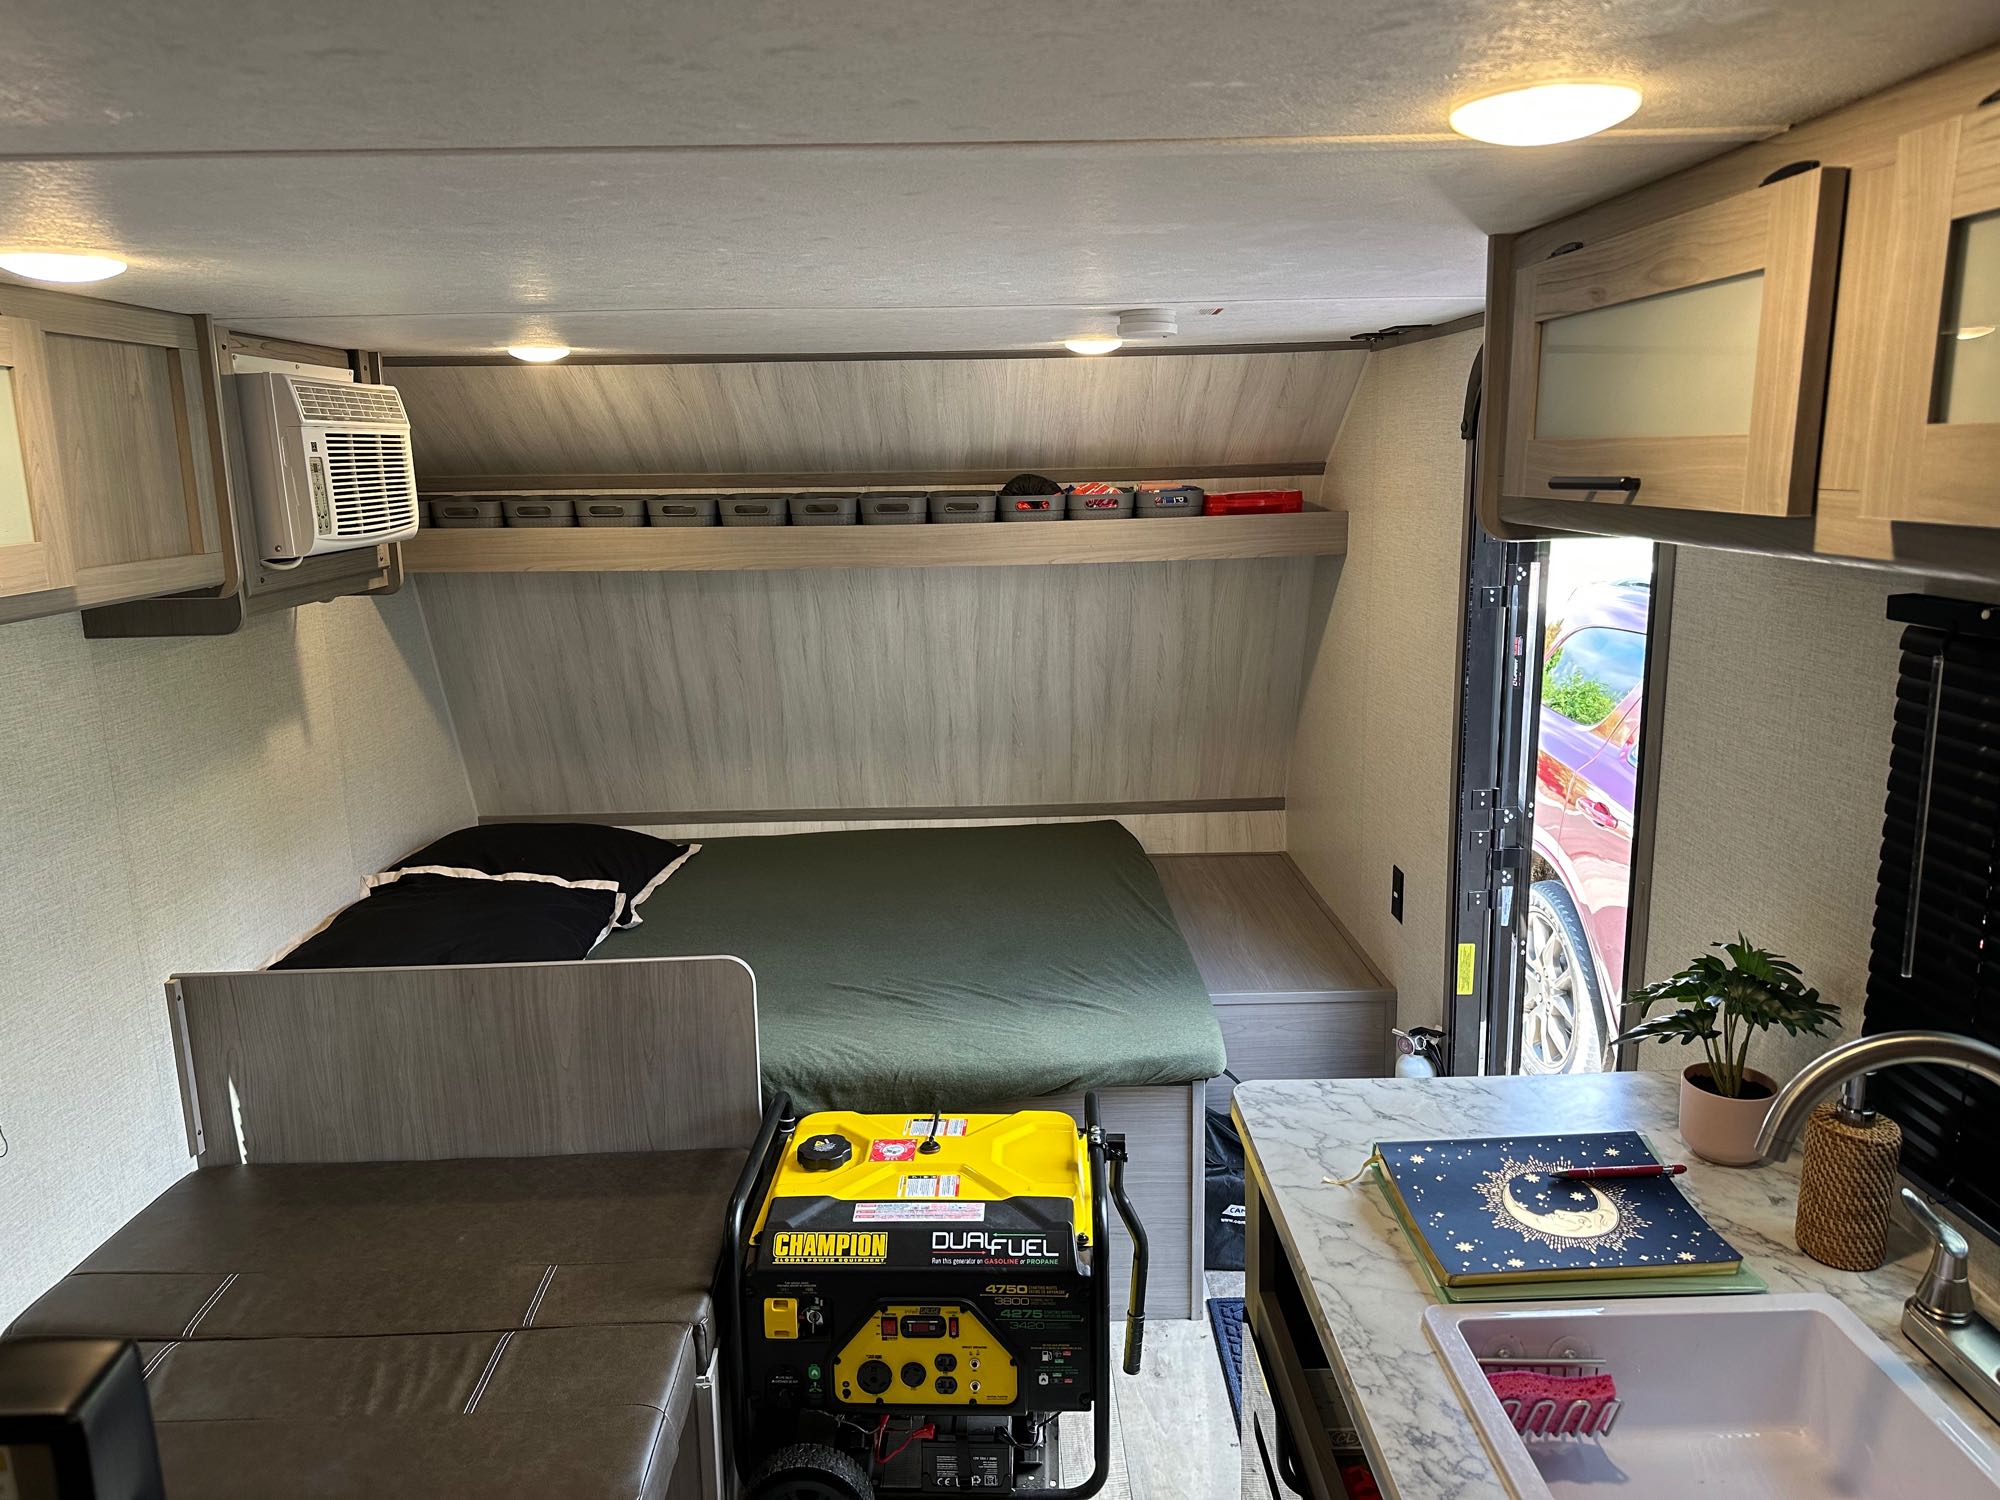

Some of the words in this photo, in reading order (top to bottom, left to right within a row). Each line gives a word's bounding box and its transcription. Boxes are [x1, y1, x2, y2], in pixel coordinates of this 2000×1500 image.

[774, 1233, 886, 1256] CHAMPION
[932, 1231, 1001, 1250] DUAL
[991, 1238, 1060, 1257] FUEL
[952, 1258, 976, 1266] generator
[985, 1284, 1028, 1294] 4750
[994, 1297, 1030, 1306] 3800
[1000, 1310, 1042, 1318] 4275
[1009, 1322, 1045, 1330] 3420
